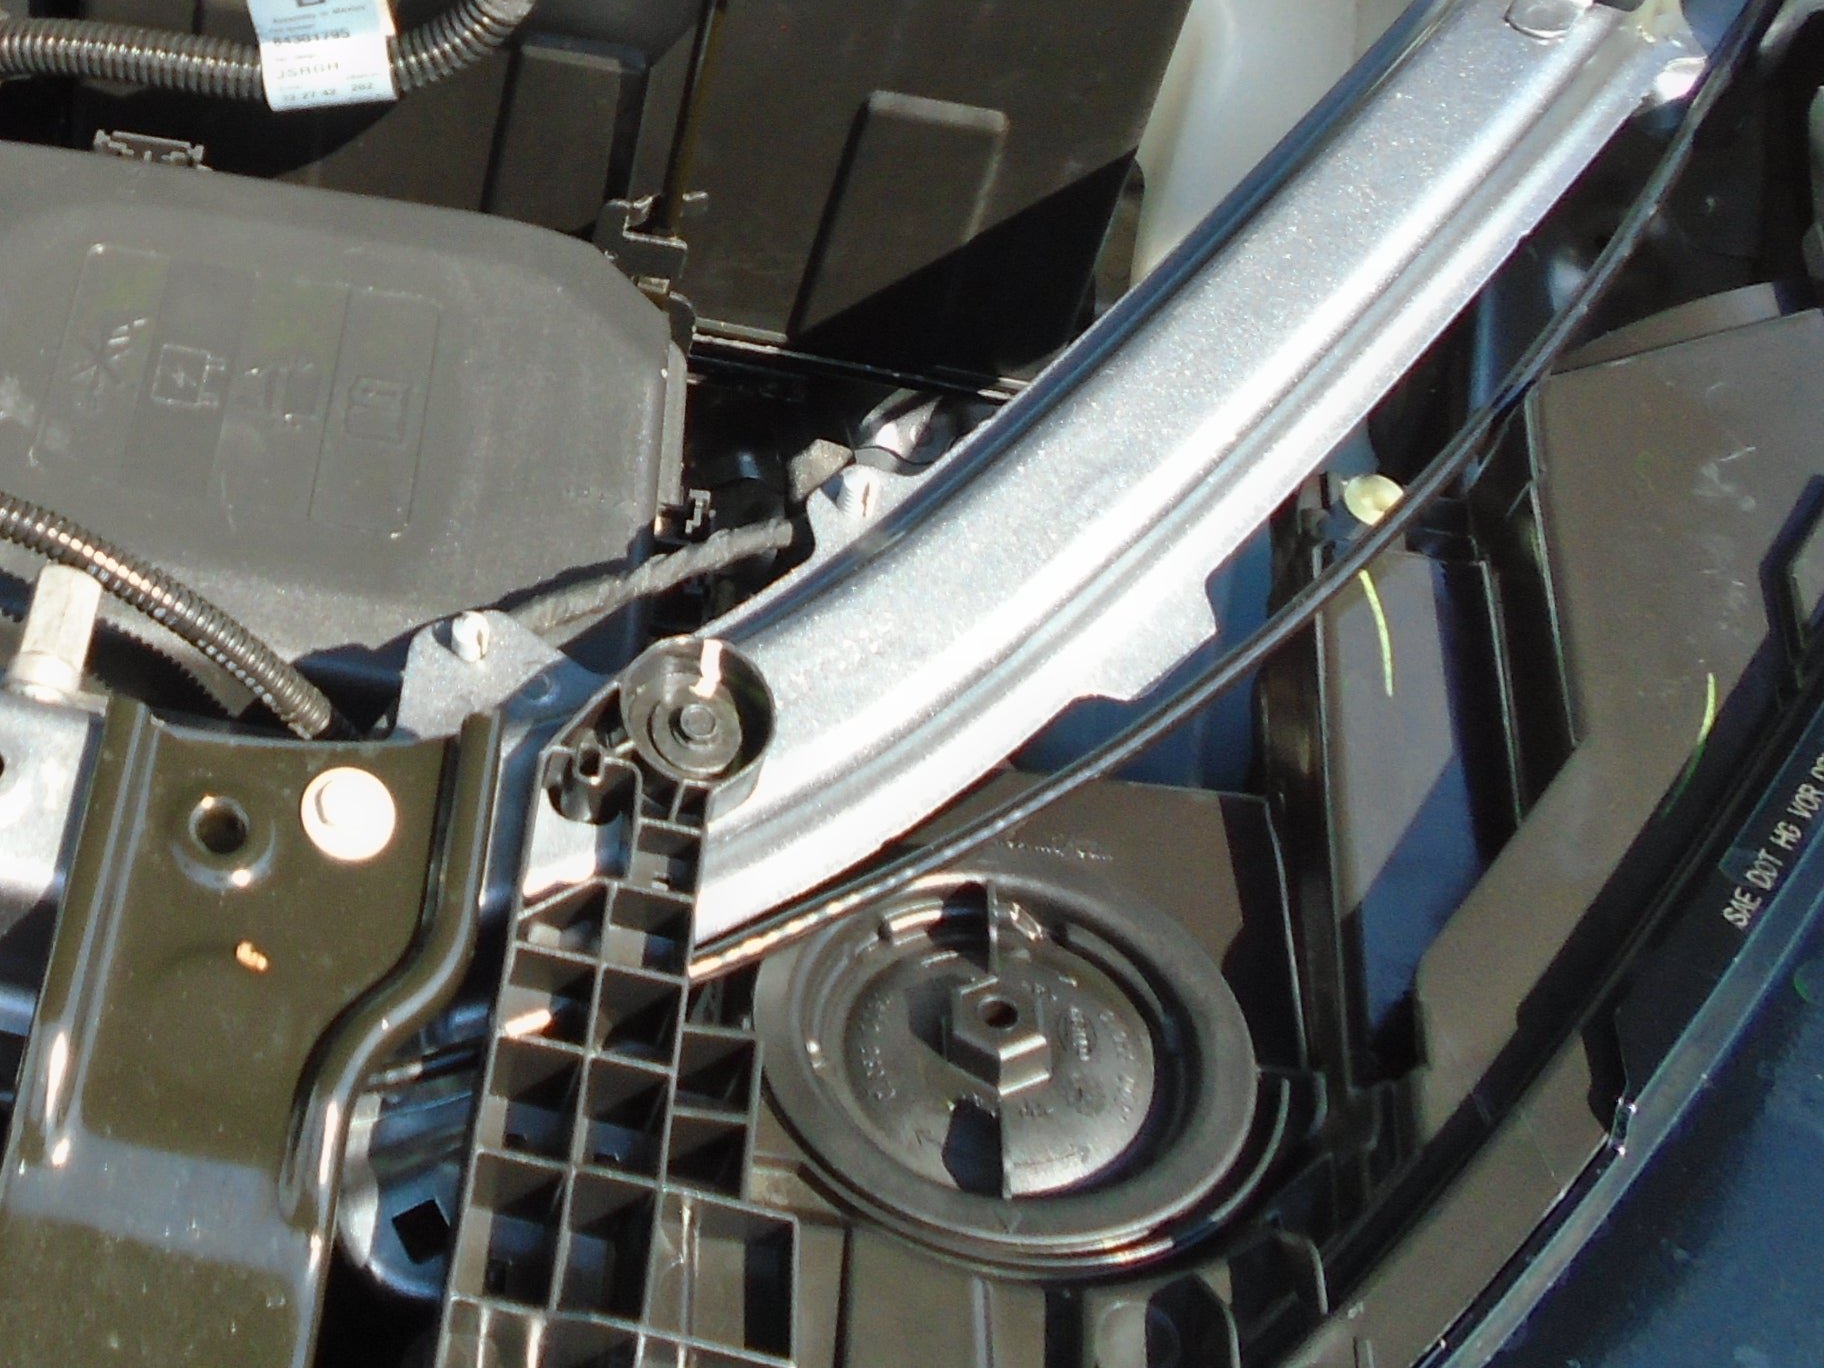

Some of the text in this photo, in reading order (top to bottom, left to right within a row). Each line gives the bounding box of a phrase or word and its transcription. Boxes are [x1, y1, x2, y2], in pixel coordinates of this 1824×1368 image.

[1722, 783, 1824, 930] SAE DOT HG VOR
